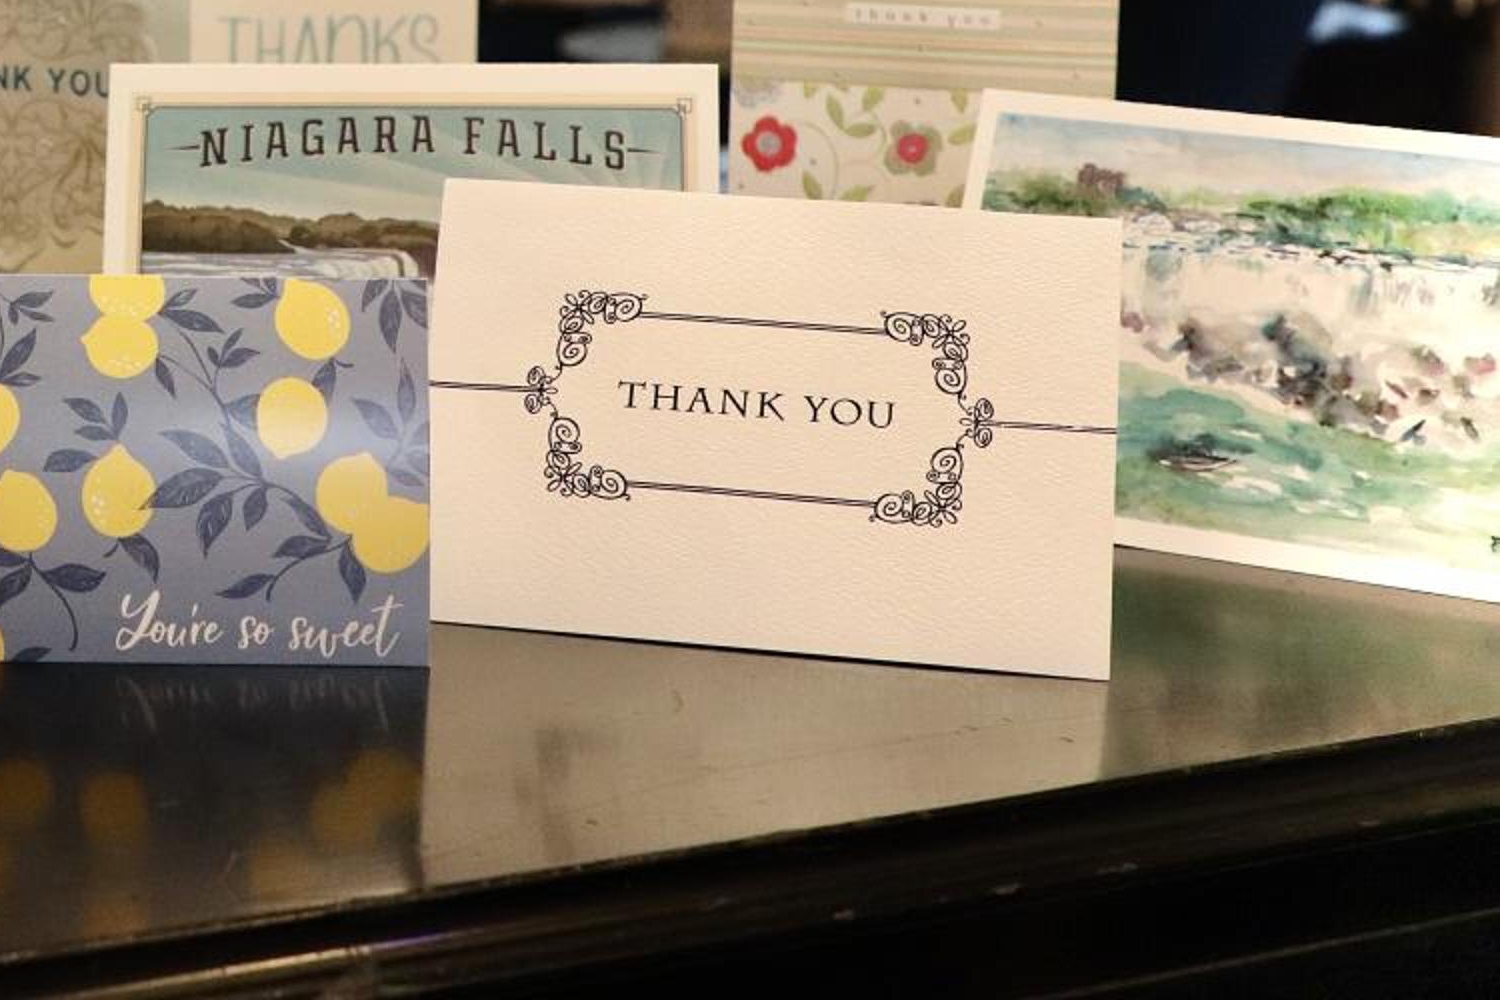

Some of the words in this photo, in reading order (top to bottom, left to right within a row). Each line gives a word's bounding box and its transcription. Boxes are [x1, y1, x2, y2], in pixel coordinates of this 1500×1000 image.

[47, 67, 109, 98] YOU
[200, 115, 436, 167] NIAGARA
[464, 117, 626, 170] FALLS
[617, 379, 785, 422] THANK
[804, 395, 895, 429] YOU
[115, 589, 224, 651] You're
[238, 615, 274, 650] so
[288, 594, 404, 658] sweet
